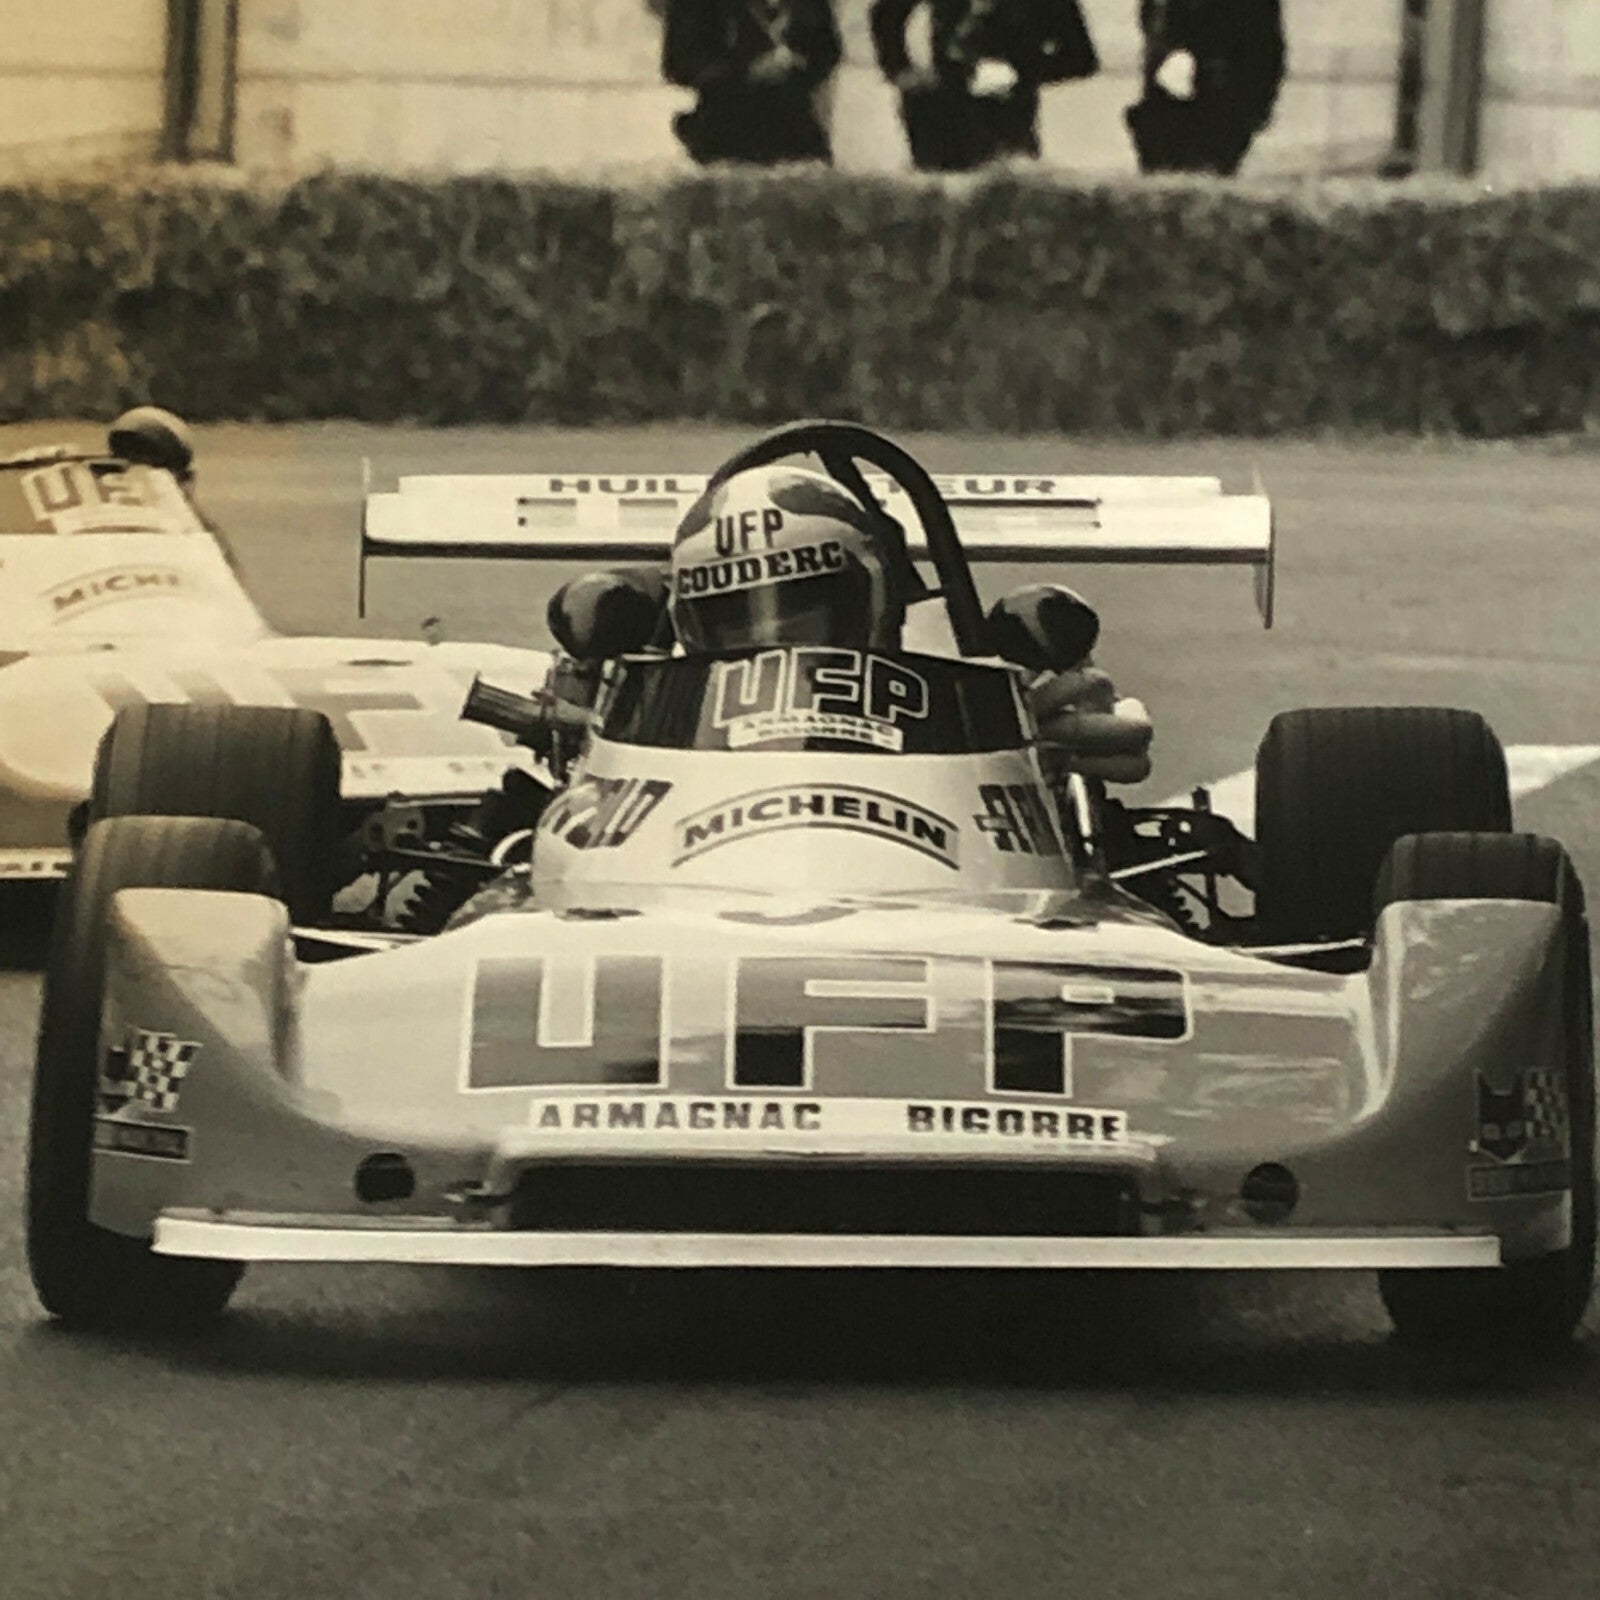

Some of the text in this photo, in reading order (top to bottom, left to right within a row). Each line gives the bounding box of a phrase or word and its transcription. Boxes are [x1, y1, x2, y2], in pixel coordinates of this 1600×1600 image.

[715, 508, 784, 557] UFP
[677, 541, 842, 595] COUDERC
[712, 646, 929, 729] UFP
[683, 794, 948, 849] MICHELIN
[459, 955, 1193, 1098] UFP
[539, 1101, 1121, 1142] ARMAGNAC BIGORRE
